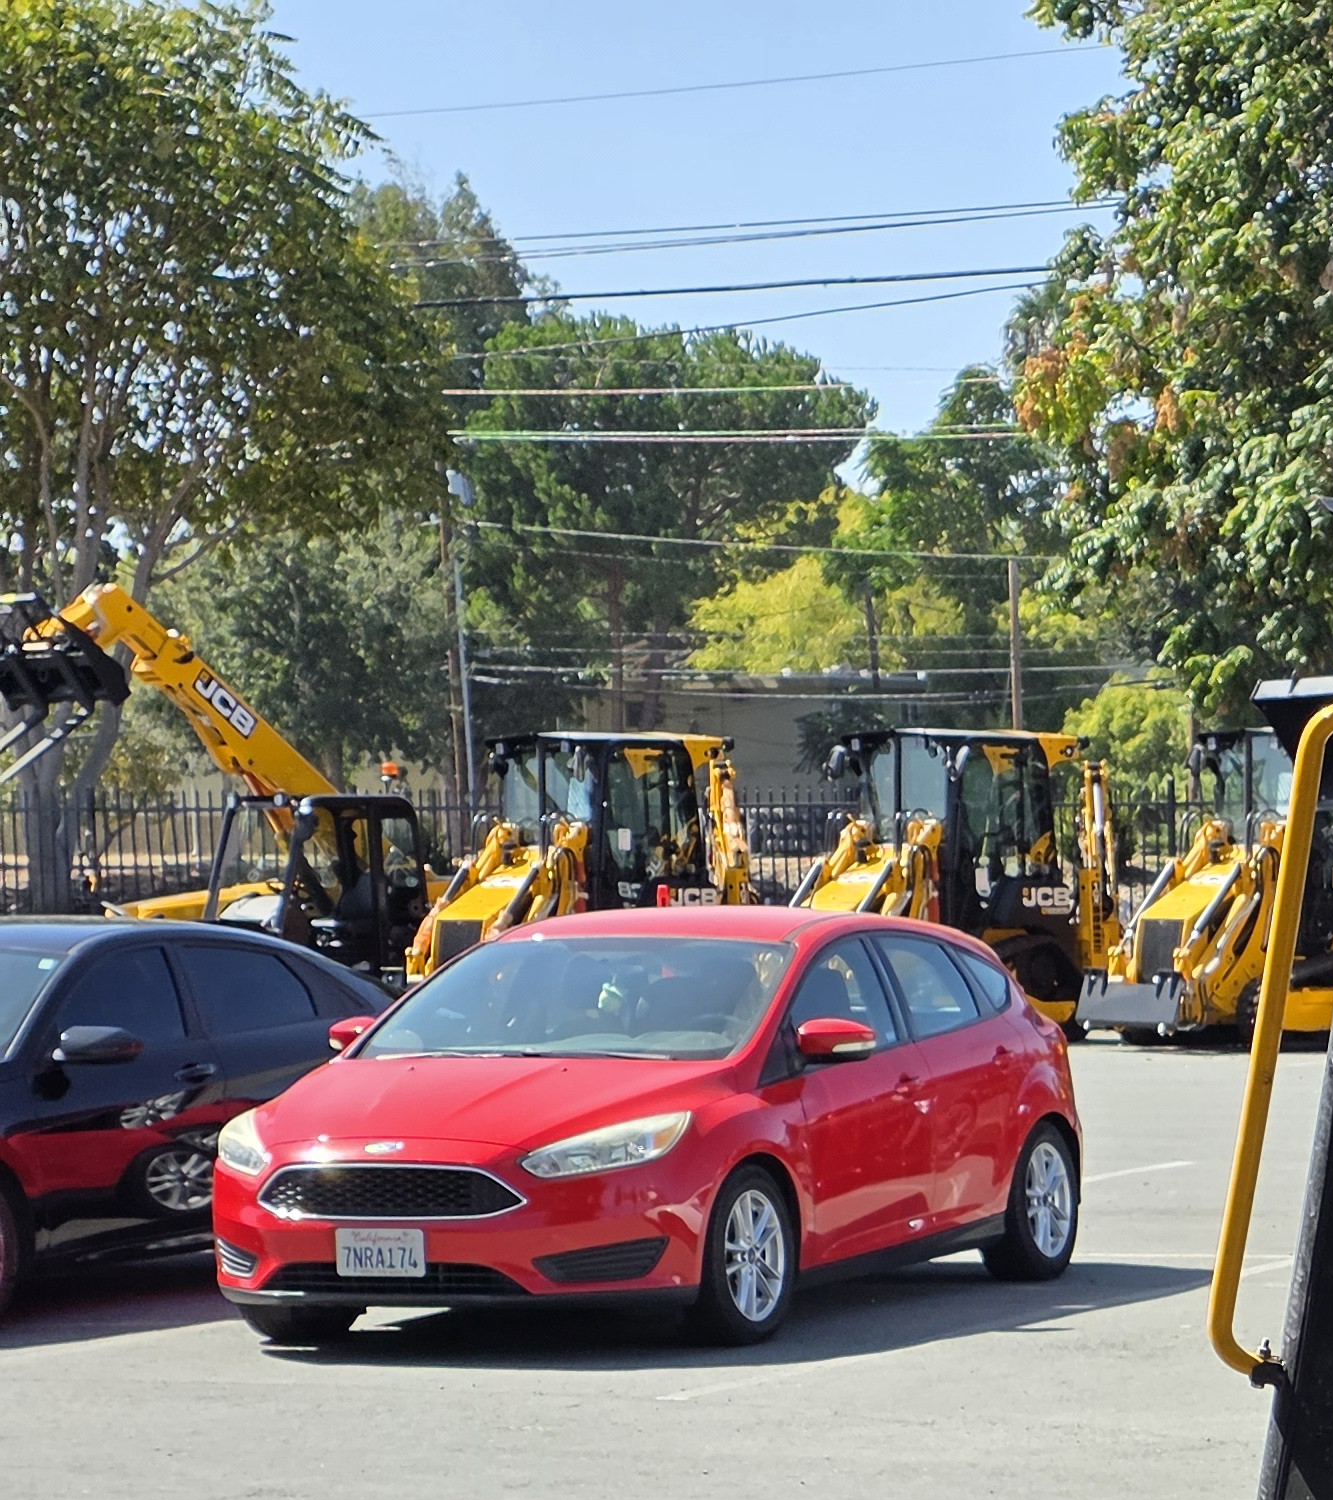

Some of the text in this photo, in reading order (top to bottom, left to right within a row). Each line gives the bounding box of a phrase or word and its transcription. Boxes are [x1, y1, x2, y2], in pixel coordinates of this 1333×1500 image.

[195, 679, 254, 736] JCB
[670, 888, 718, 906] JCB
[1022, 886, 1069, 907] JCB
[342, 1246, 417, 1269] 7NRA174
